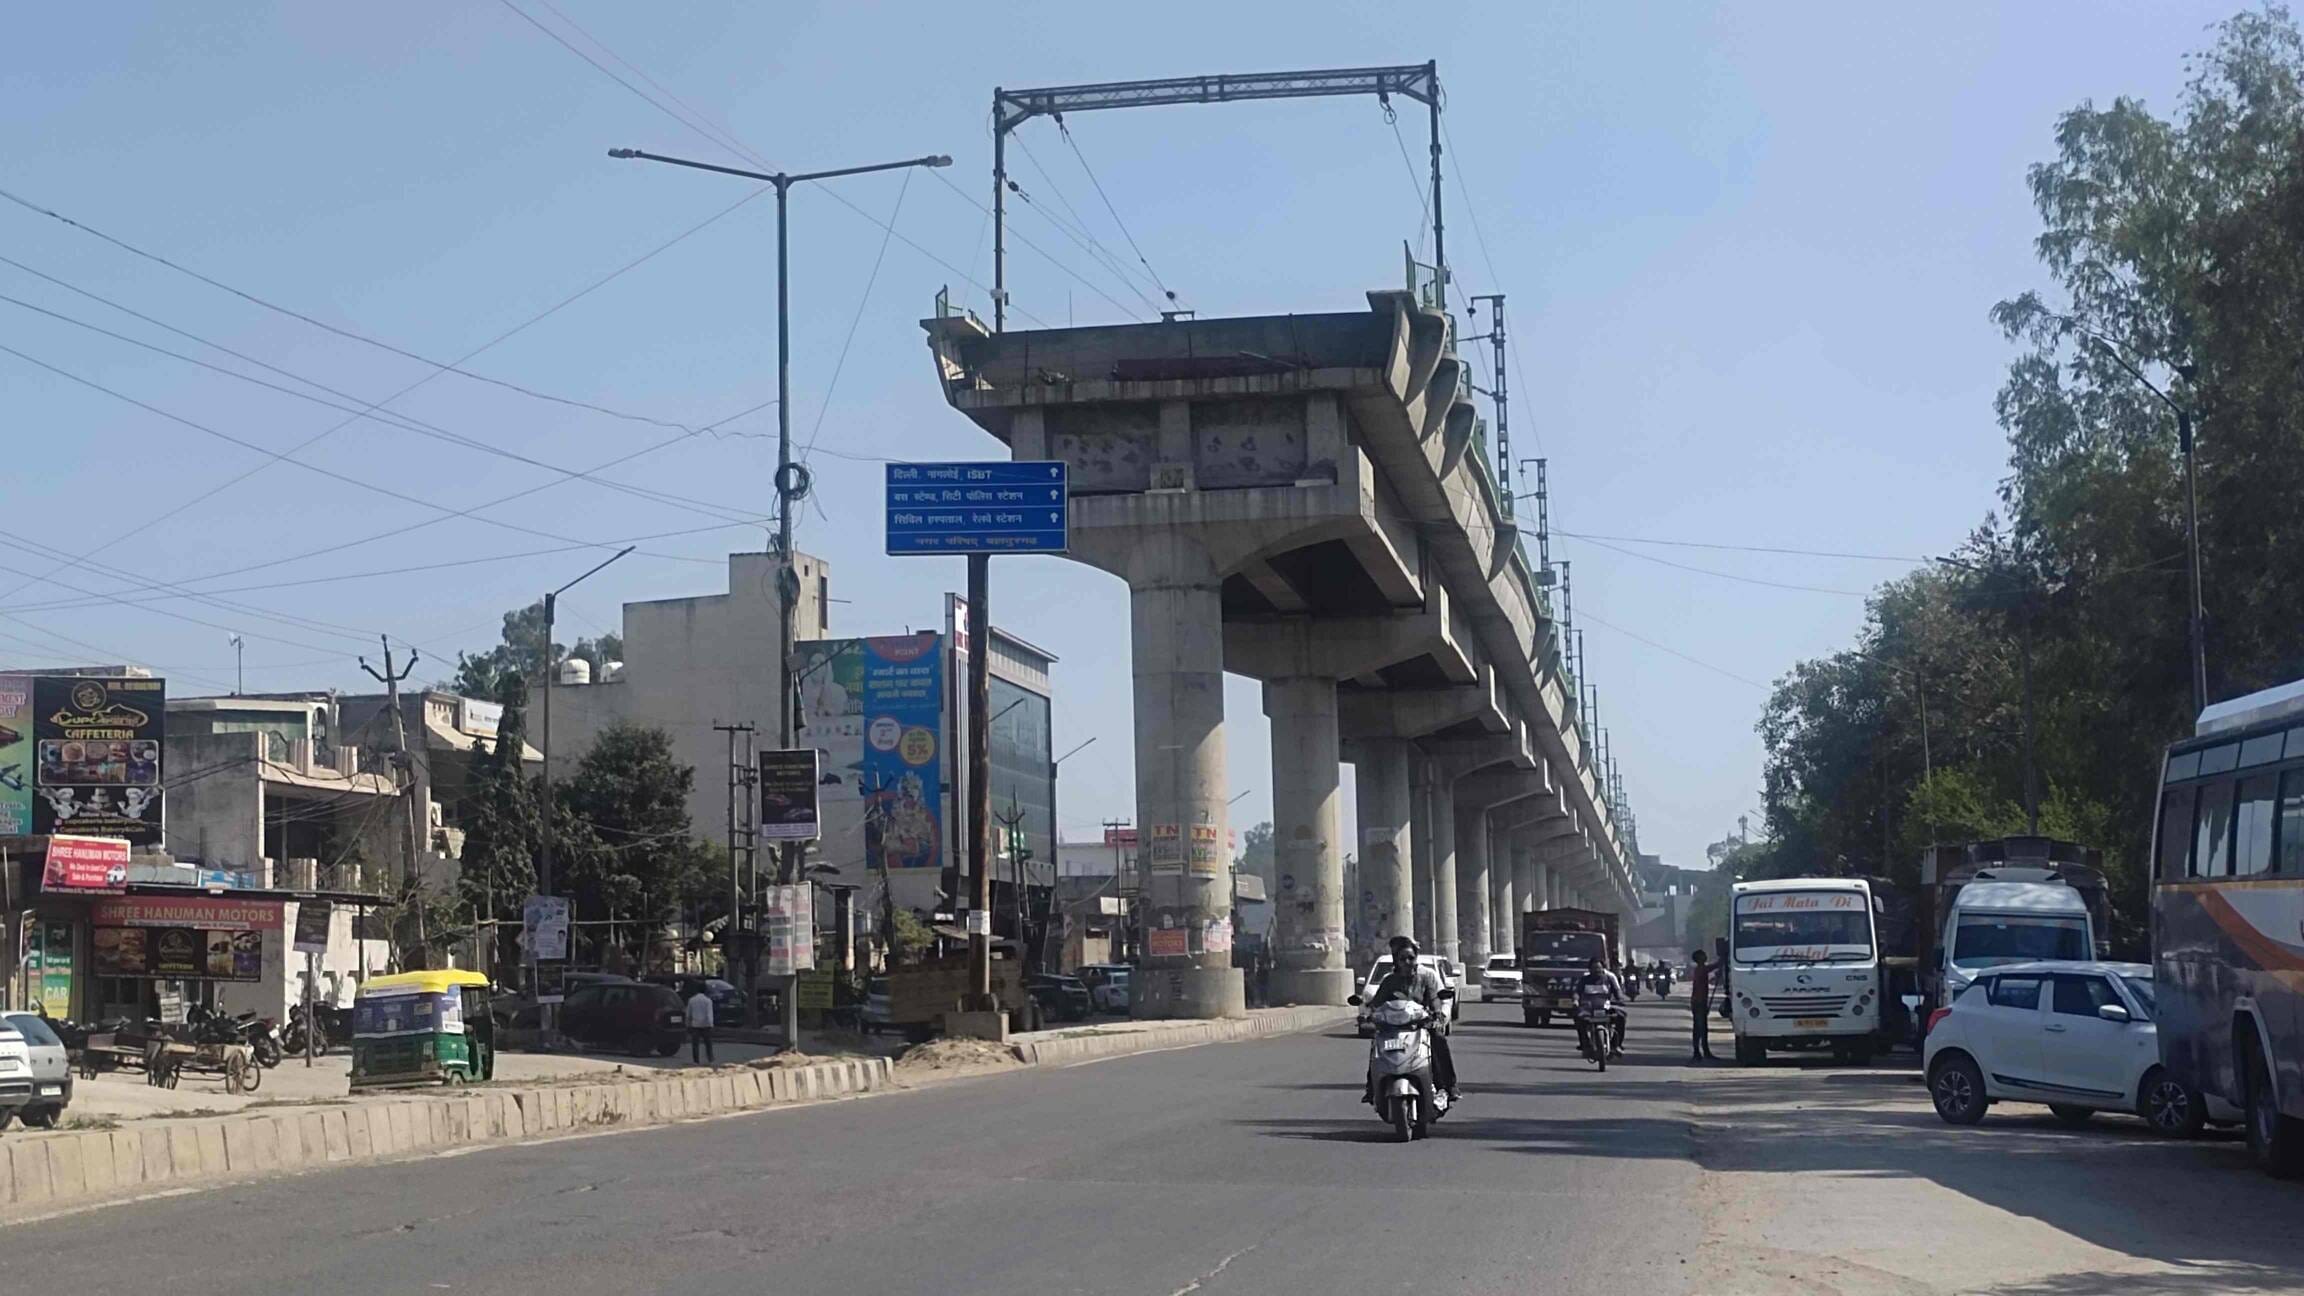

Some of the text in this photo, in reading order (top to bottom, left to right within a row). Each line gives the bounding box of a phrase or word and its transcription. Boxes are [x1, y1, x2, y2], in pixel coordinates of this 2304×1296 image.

[967, 469, 993, 480] ISBT
[64, 729, 134, 739] CAFFETERIA
[907, 744, 929, 756] 5%
[52, 846, 73, 857] SHREE
[103, 850, 127, 861] MOTORS
[1782, 896, 1819, 908] Mata
[1829, 895, 1852, 908] Di
[101, 906, 274, 922] SHREE HANUMAN MOTORS
[44, 986, 68, 1000] CAR
